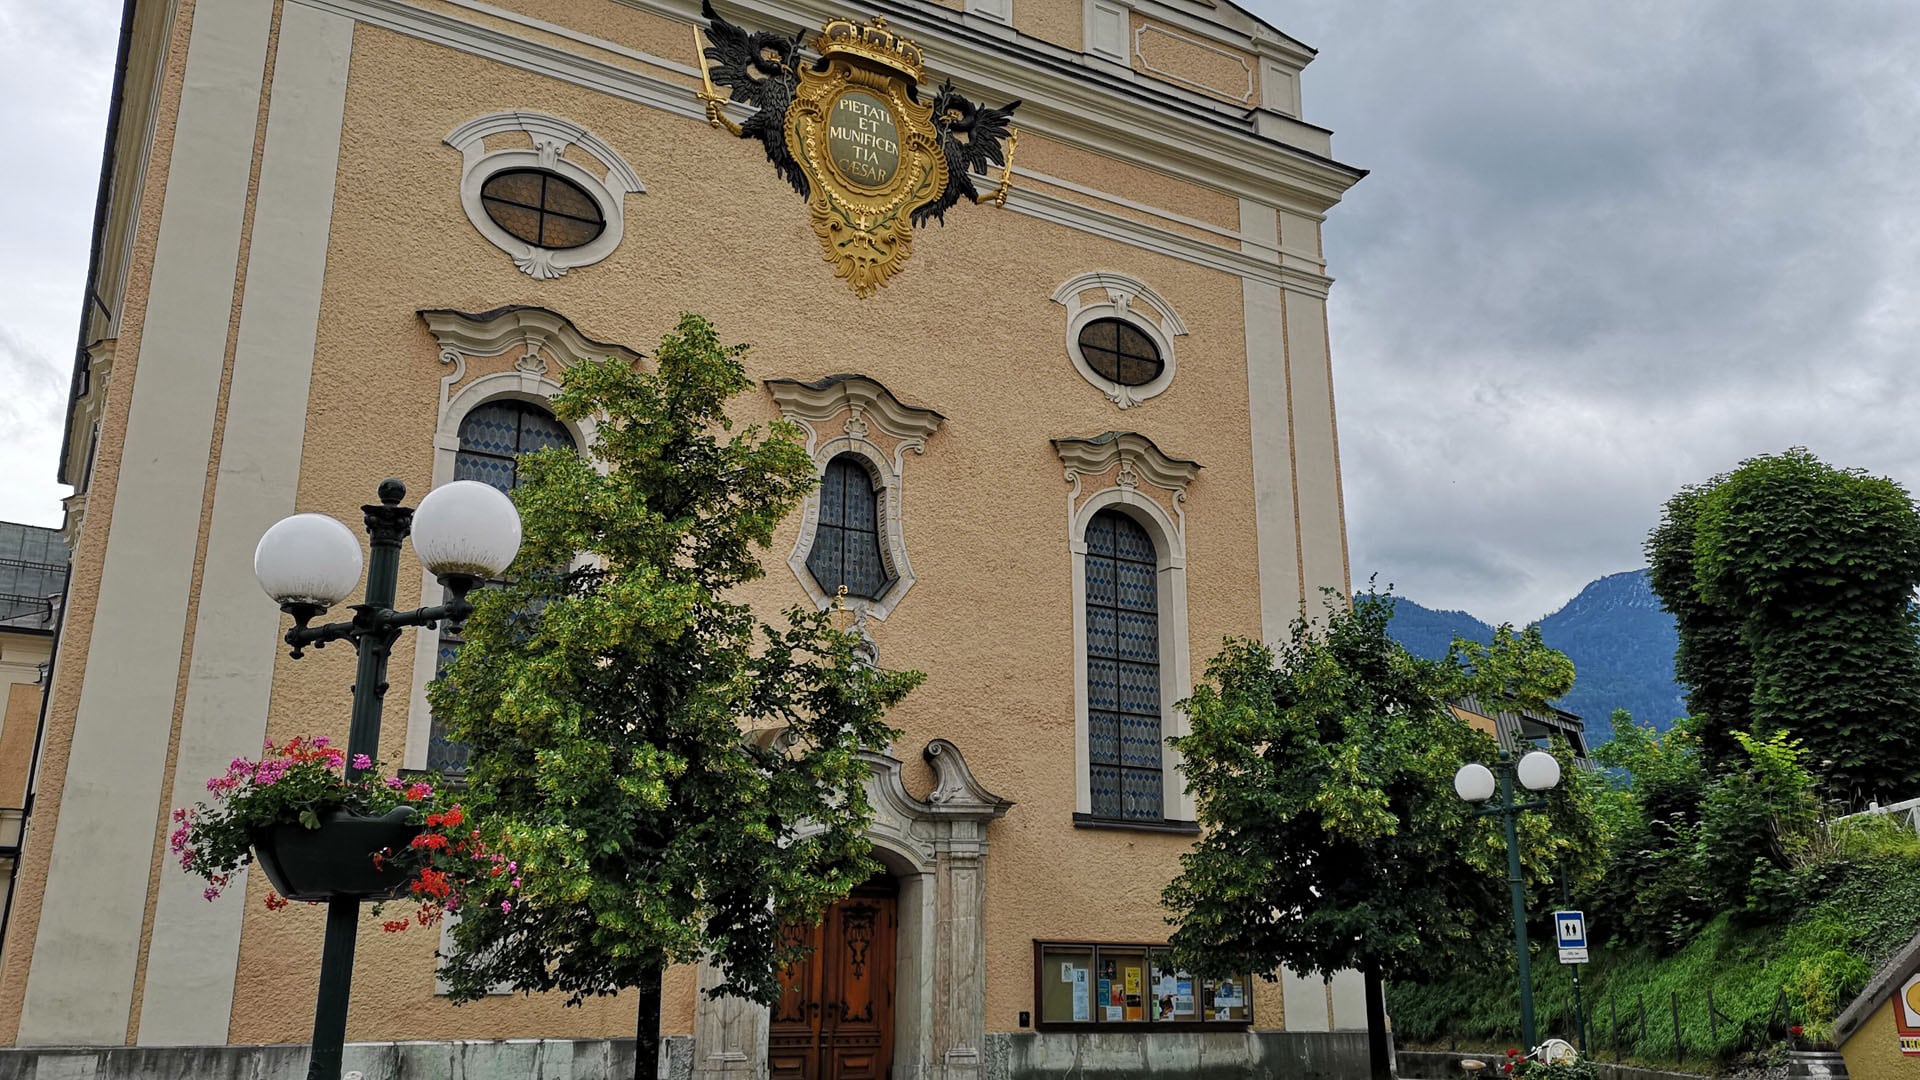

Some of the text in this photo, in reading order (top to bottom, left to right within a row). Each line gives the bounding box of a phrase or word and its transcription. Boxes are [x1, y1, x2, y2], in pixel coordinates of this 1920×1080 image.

[859, 117, 880, 133] ET
[830, 126, 898, 156] MUNIFICEN
[852, 145, 879, 165] TIA
